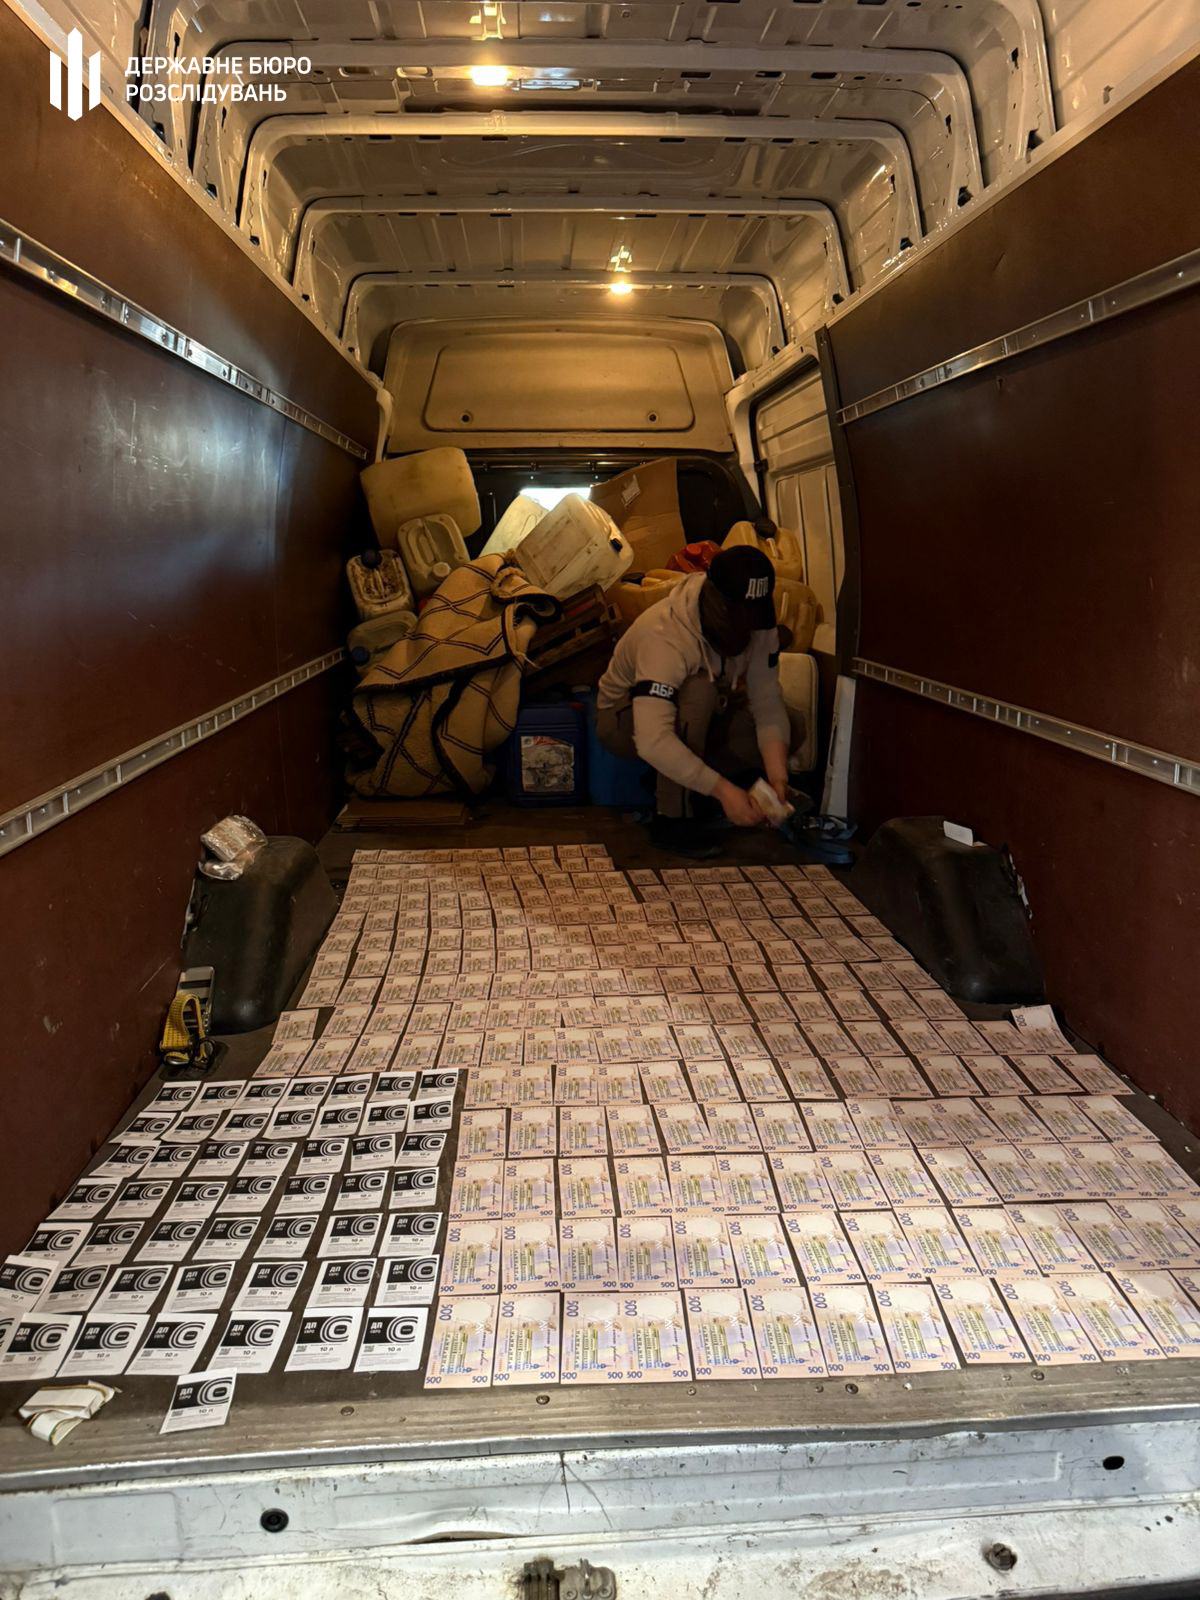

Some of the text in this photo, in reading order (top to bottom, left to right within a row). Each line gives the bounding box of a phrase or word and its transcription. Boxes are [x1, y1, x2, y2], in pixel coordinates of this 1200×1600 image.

[650, 683, 674, 698] ДБР
[936, 1284, 952, 1300] 500
[751, 1294, 764, 1312] 500
[813, 1292, 827, 1309] 500
[877, 1290, 891, 1307] 500
[502, 1300, 513, 1316] 500
[567, 1299, 578, 1316] 500
[625, 1300, 636, 1316] 500
[689, 1296, 701, 1312] 500
[441, 1304, 452, 1320] 500
[627, 1370, 642, 1378] 500
[673, 1369, 688, 1378] 500
[763, 1366, 778, 1374] 500
[808, 1366, 824, 1374] 500
[472, 1374, 488, 1383] 500
[494, 1372, 510, 1381] 500
[540, 1371, 556, 1379] 500
[562, 1372, 577, 1380] 500
[608, 1371, 623, 1379] 500
[426, 1376, 441, 1384] 500
[180, 1388, 192, 1396] ДП
